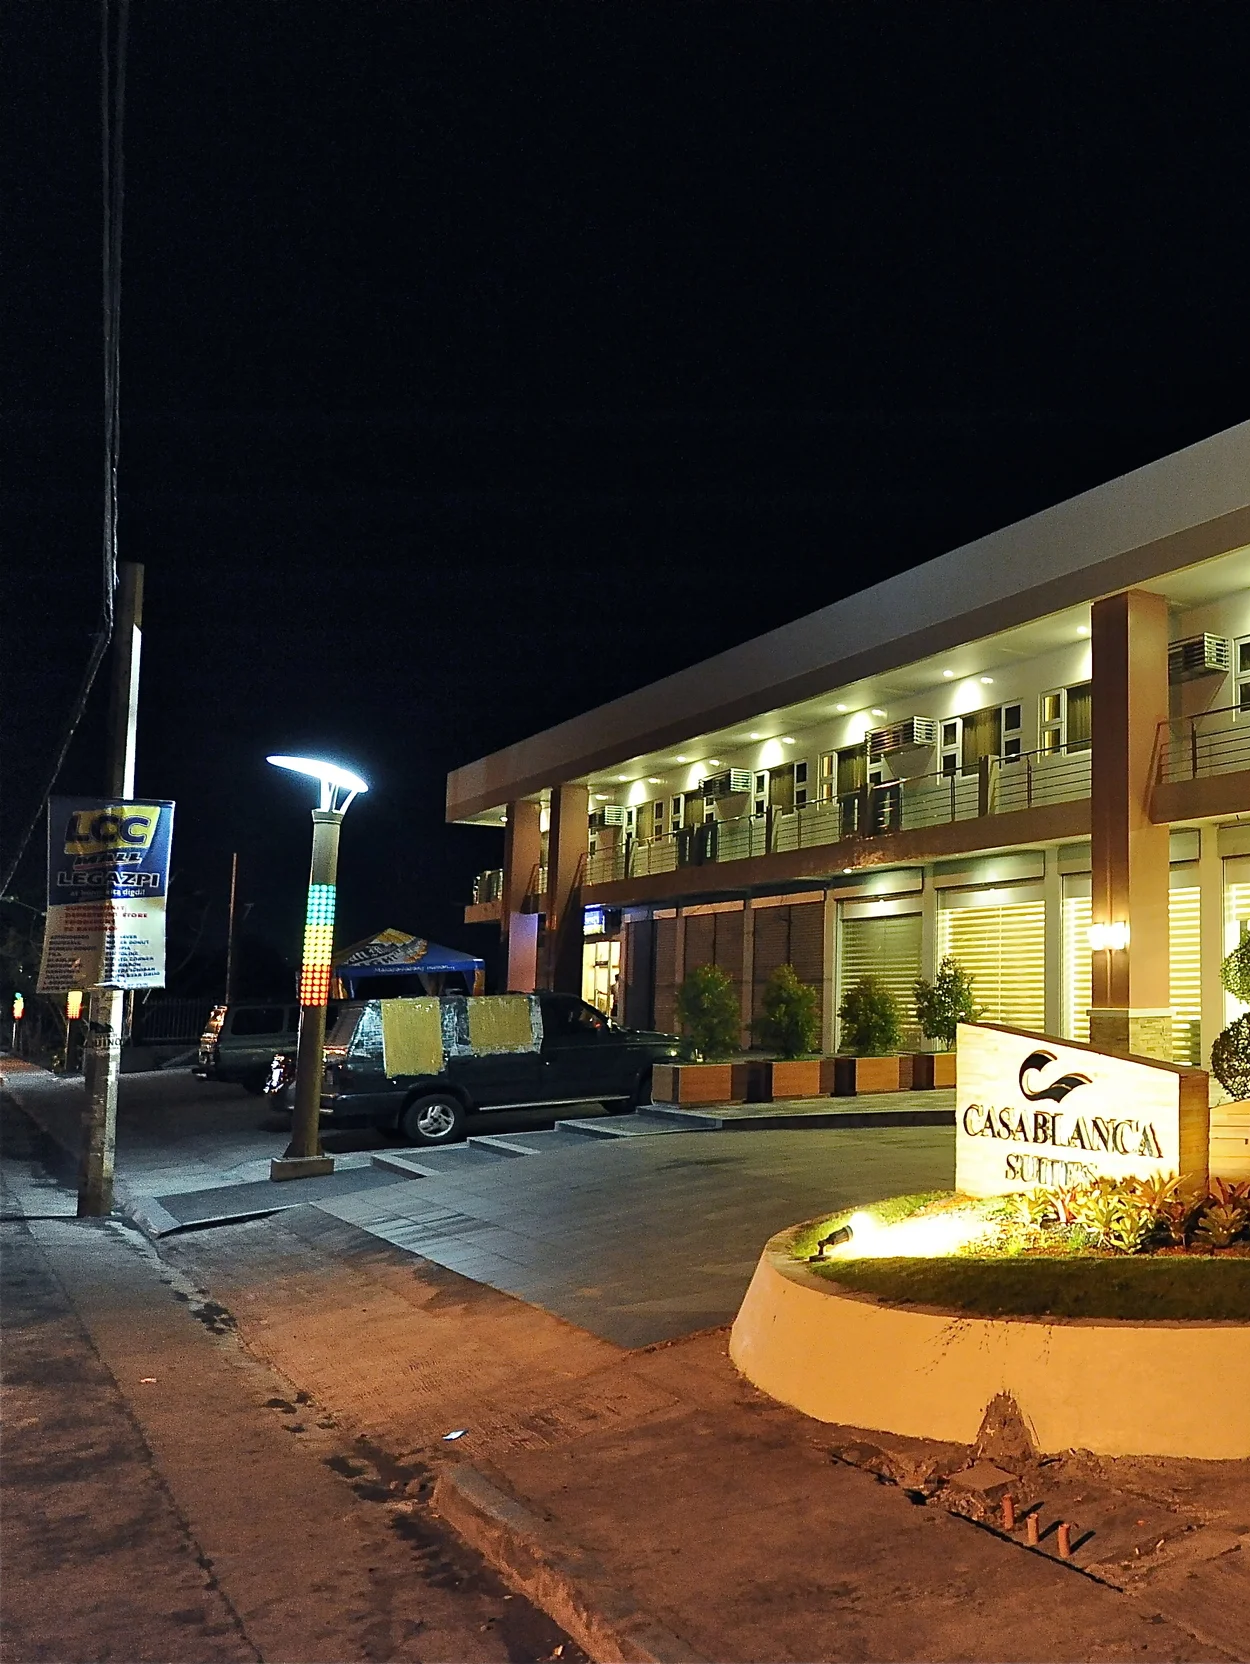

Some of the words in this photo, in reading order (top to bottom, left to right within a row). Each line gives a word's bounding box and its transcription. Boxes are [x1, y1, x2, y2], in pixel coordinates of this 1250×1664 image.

[57, 871, 160, 888] LEGAZPI
[963, 1103, 1164, 1159] CASABLANCA
[1004, 1152, 1097, 1190] SUITES
